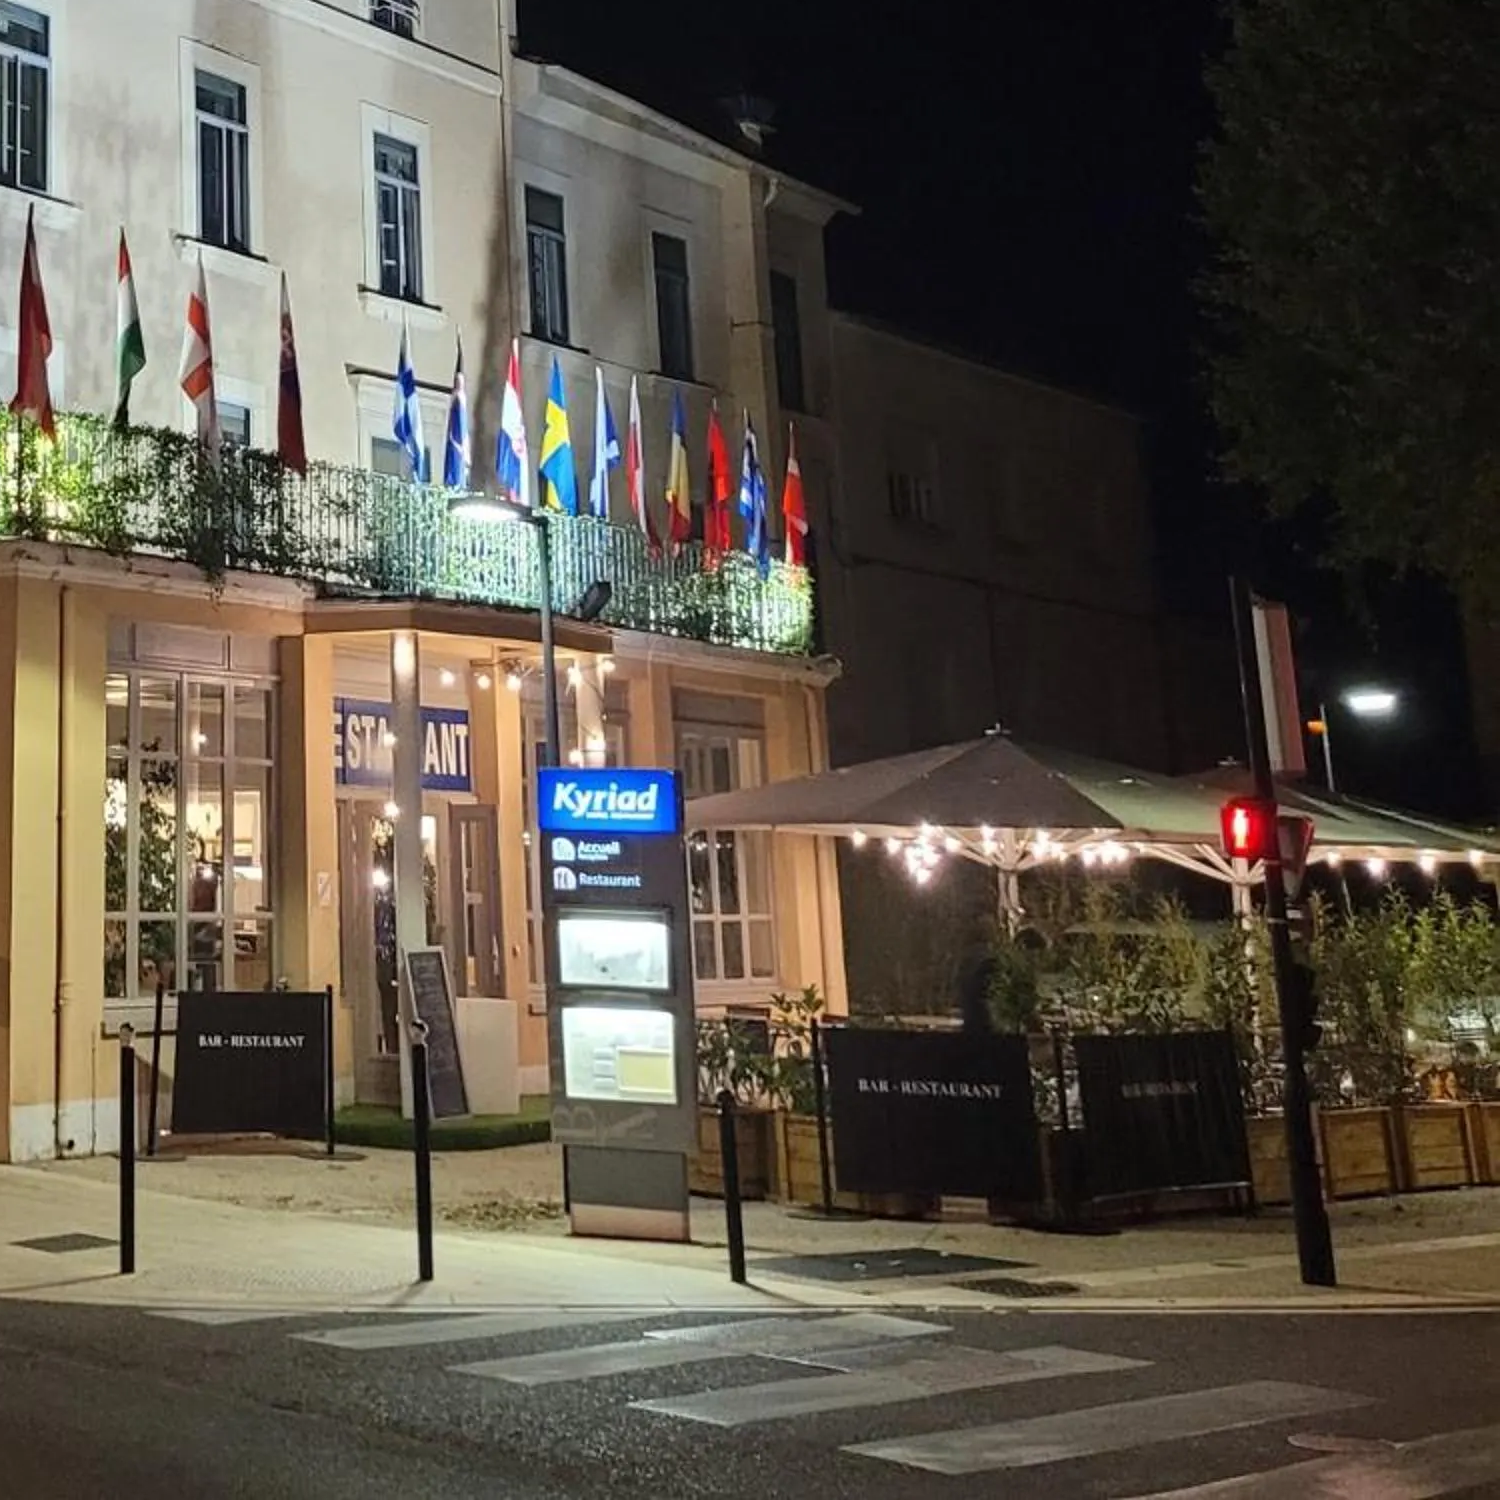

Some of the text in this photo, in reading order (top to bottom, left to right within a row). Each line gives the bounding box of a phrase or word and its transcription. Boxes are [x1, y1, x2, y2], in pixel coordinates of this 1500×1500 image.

[333, 711, 468, 776] ESTAANT
[553, 781, 659, 819] Kyriad
[578, 840, 620, 855] Accueil
[579, 872, 641, 887] Restaurant
[199, 1035, 222, 1047] BAR
[231, 1035, 305, 1048] RESTAURANT
[858, 1078, 889, 1093] BAR
[900, 1080, 1001, 1099] RESTAURANT
